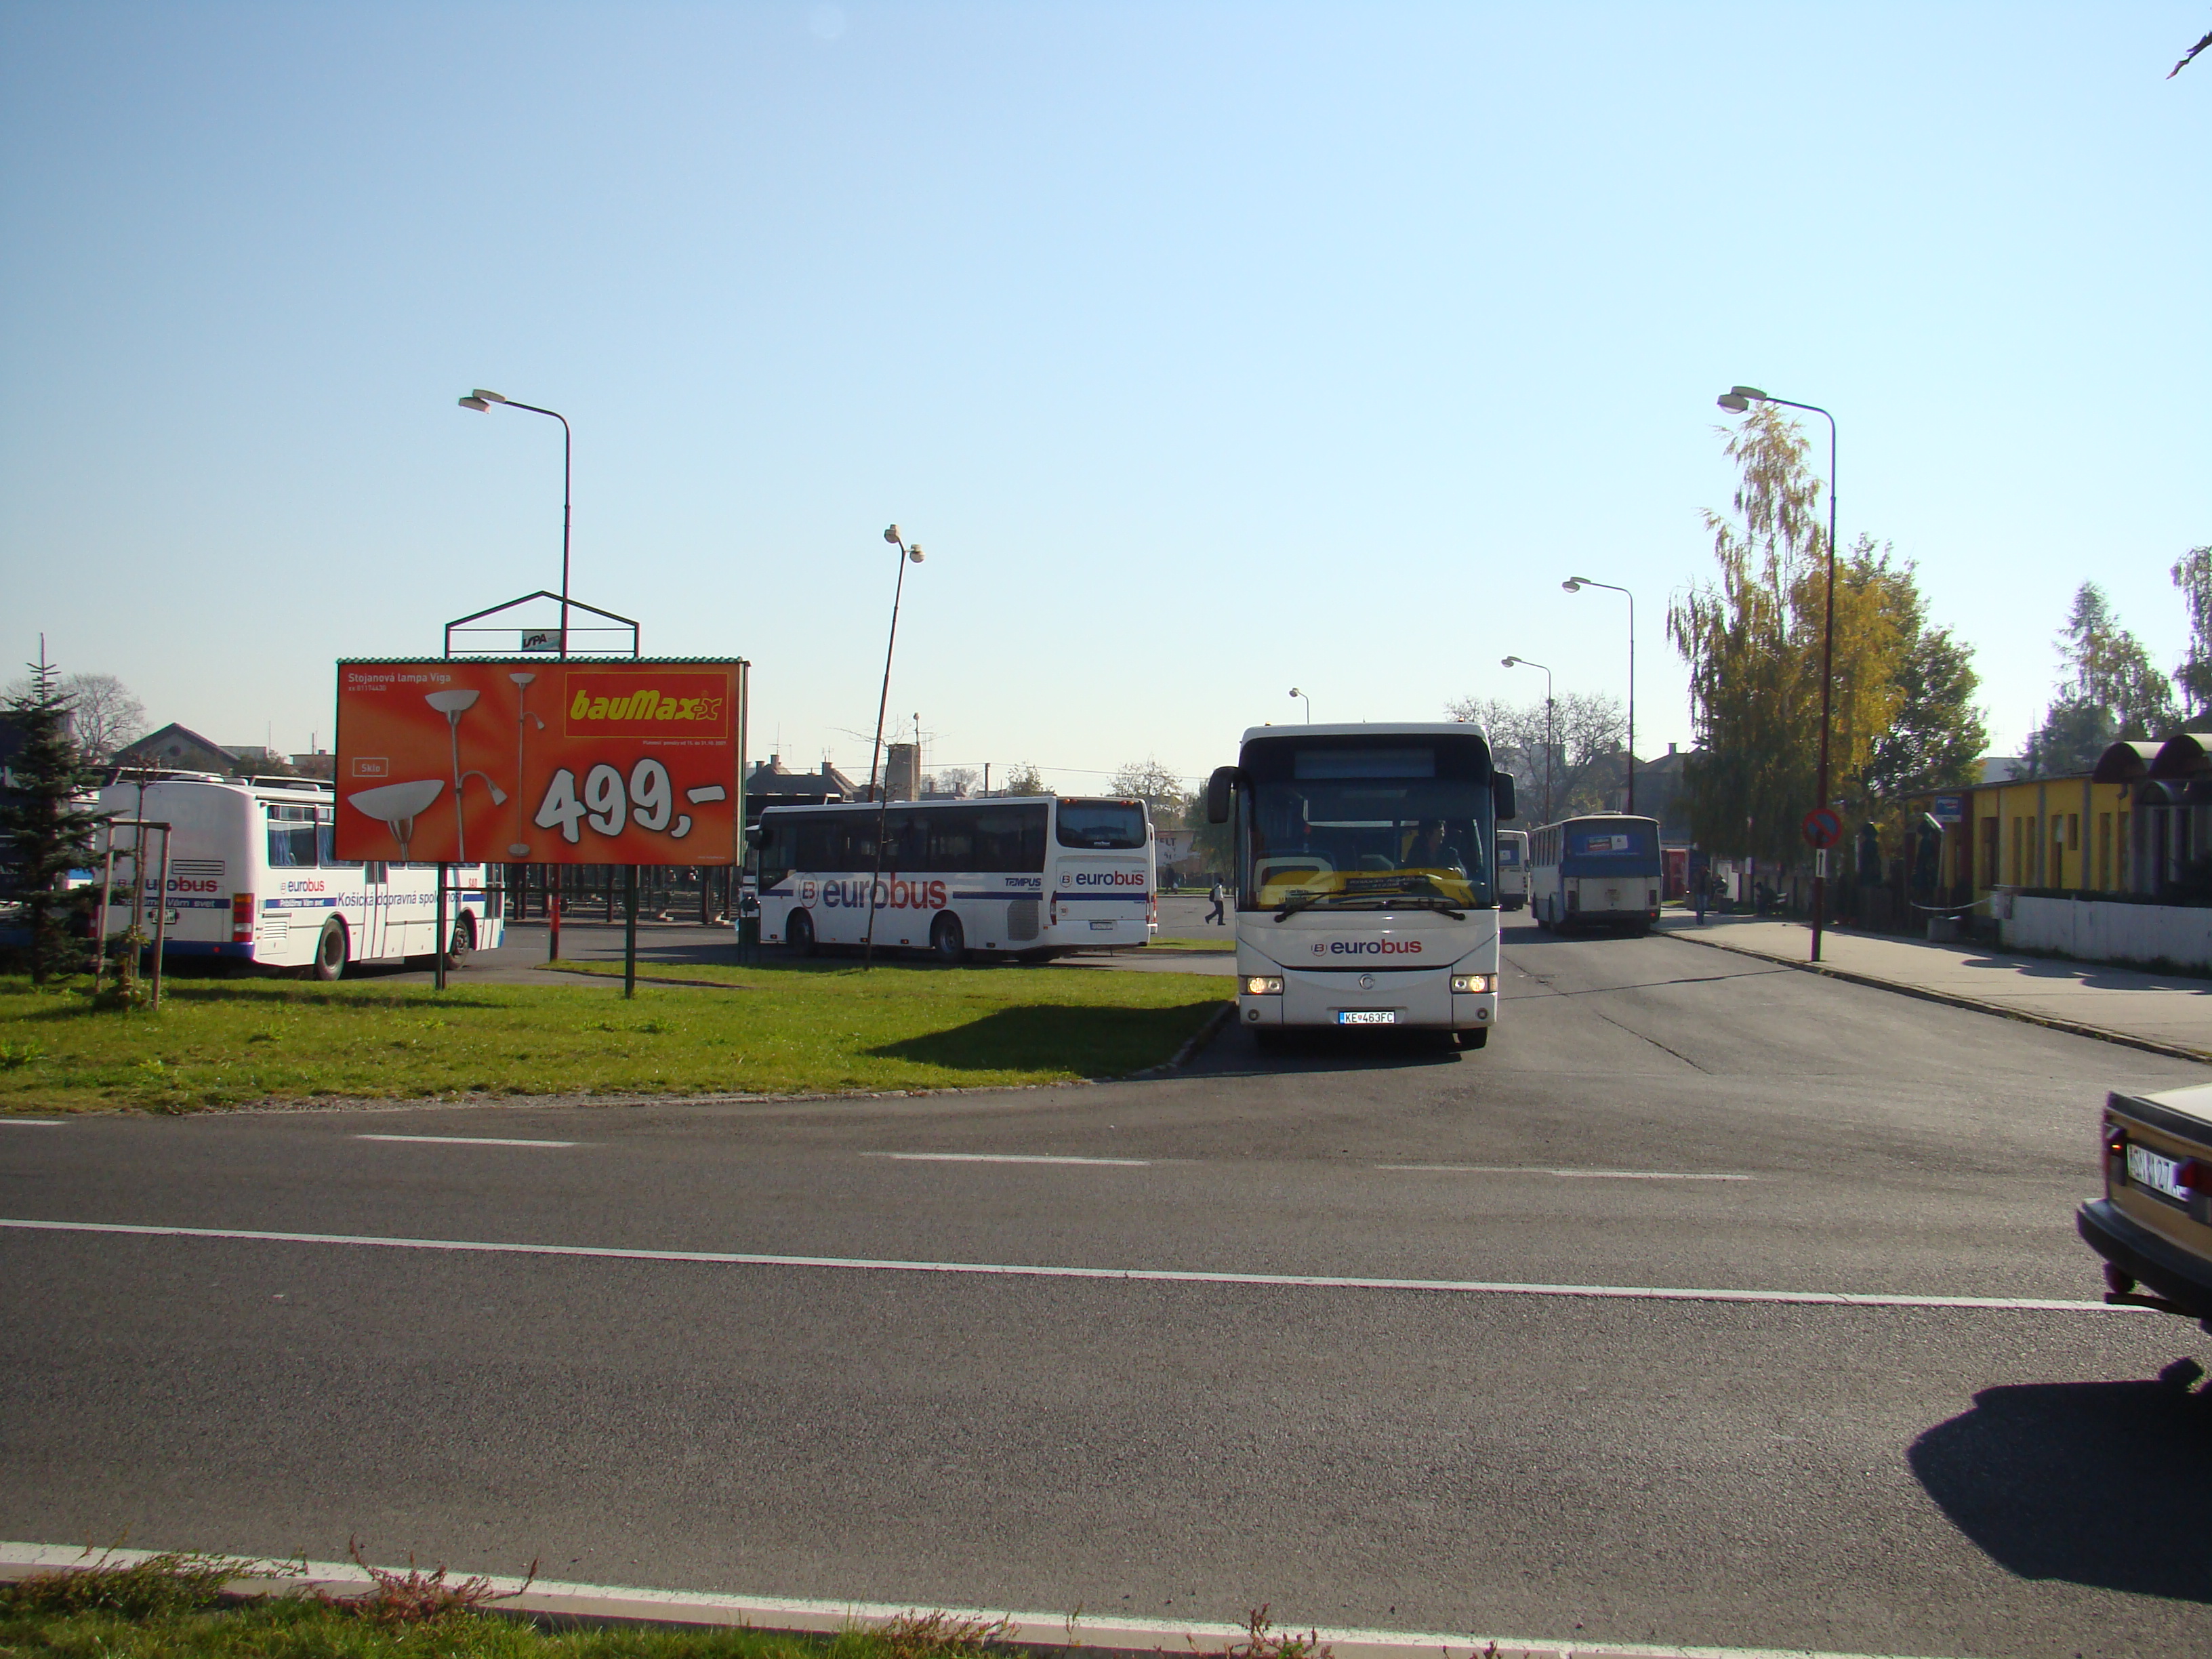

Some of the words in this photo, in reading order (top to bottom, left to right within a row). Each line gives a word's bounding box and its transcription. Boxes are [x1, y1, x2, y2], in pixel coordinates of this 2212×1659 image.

[348, 673, 394, 684] Stojanová
[398, 673, 427, 684] lampa
[361, 764, 380, 772] Sklo
[535, 758, 726, 843] 499,-
[288, 878, 325, 892] eurobus
[1005, 878, 1041, 886] TEMPUS
[1076, 871, 1144, 885] eurobus
[823, 872, 947, 909] eurobus
[193, 900, 216, 909] svet
[337, 892, 373, 907] Košická
[375, 890, 417, 909] dopravná
[1330, 939, 1422, 954] eurobus
